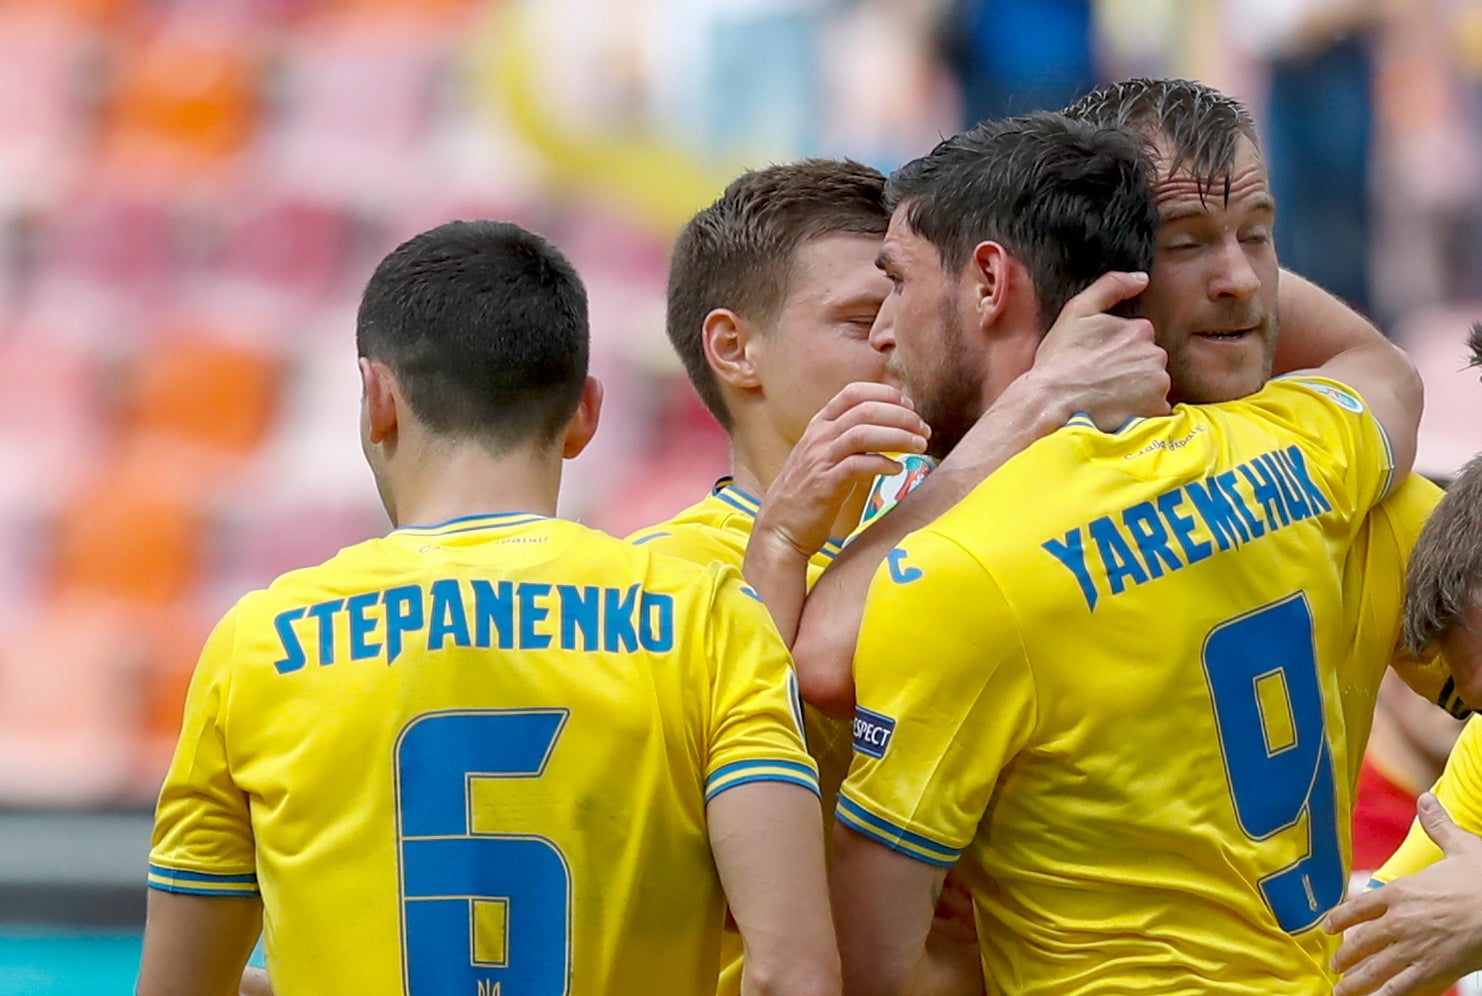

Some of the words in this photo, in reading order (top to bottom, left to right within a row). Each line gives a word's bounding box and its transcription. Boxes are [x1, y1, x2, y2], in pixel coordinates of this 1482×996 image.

[1041, 444, 1333, 614] YAREMCHUK
[273, 578, 674, 675] STEPANENKO
[853, 716, 891, 746] SPECT
[1201, 588, 1347, 937] 9
